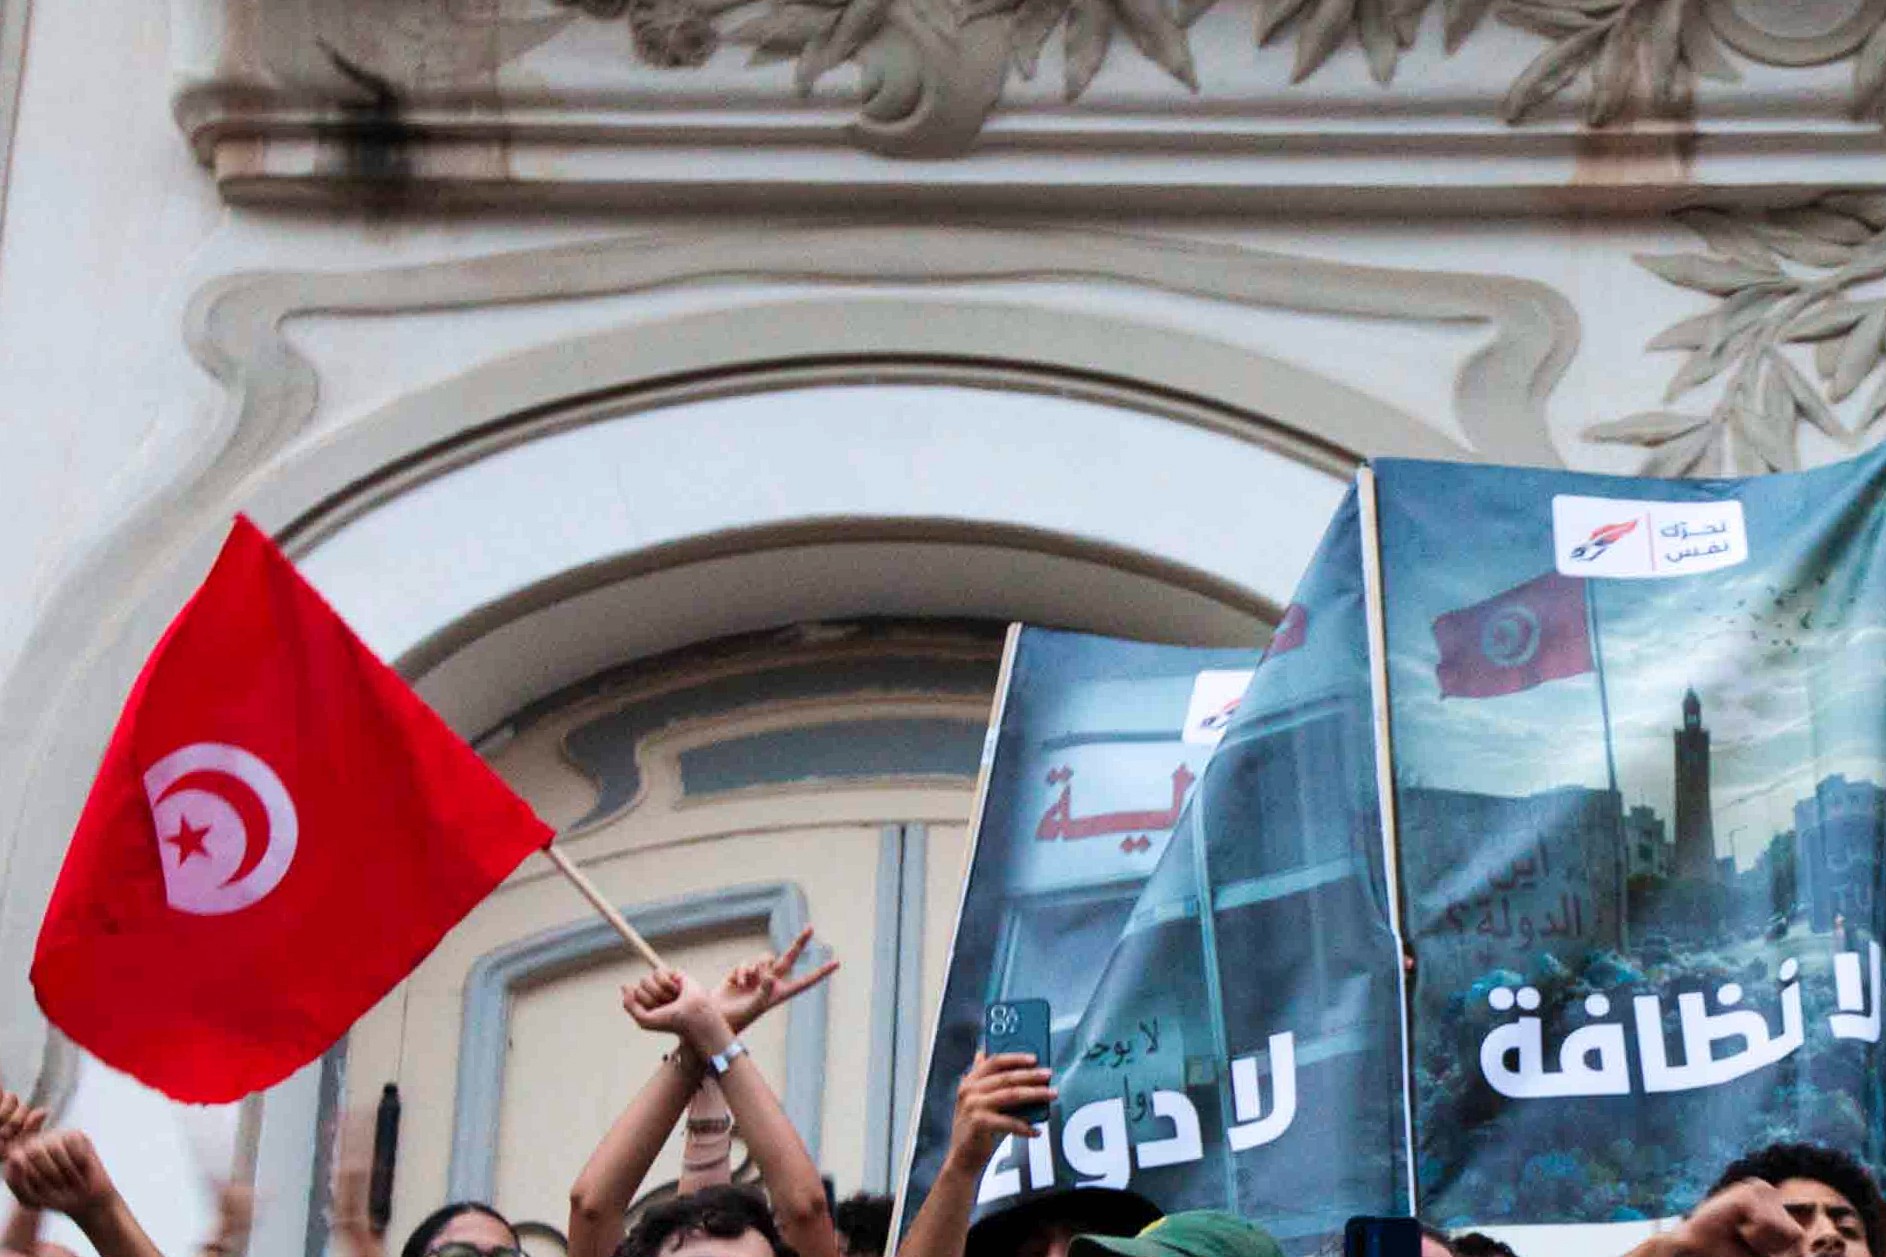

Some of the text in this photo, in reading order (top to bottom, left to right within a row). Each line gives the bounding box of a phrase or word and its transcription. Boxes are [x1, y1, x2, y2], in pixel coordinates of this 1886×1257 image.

[1481, 942, 1880, 1098] لا نظافة
[1228, 1031, 1297, 1152] لا
